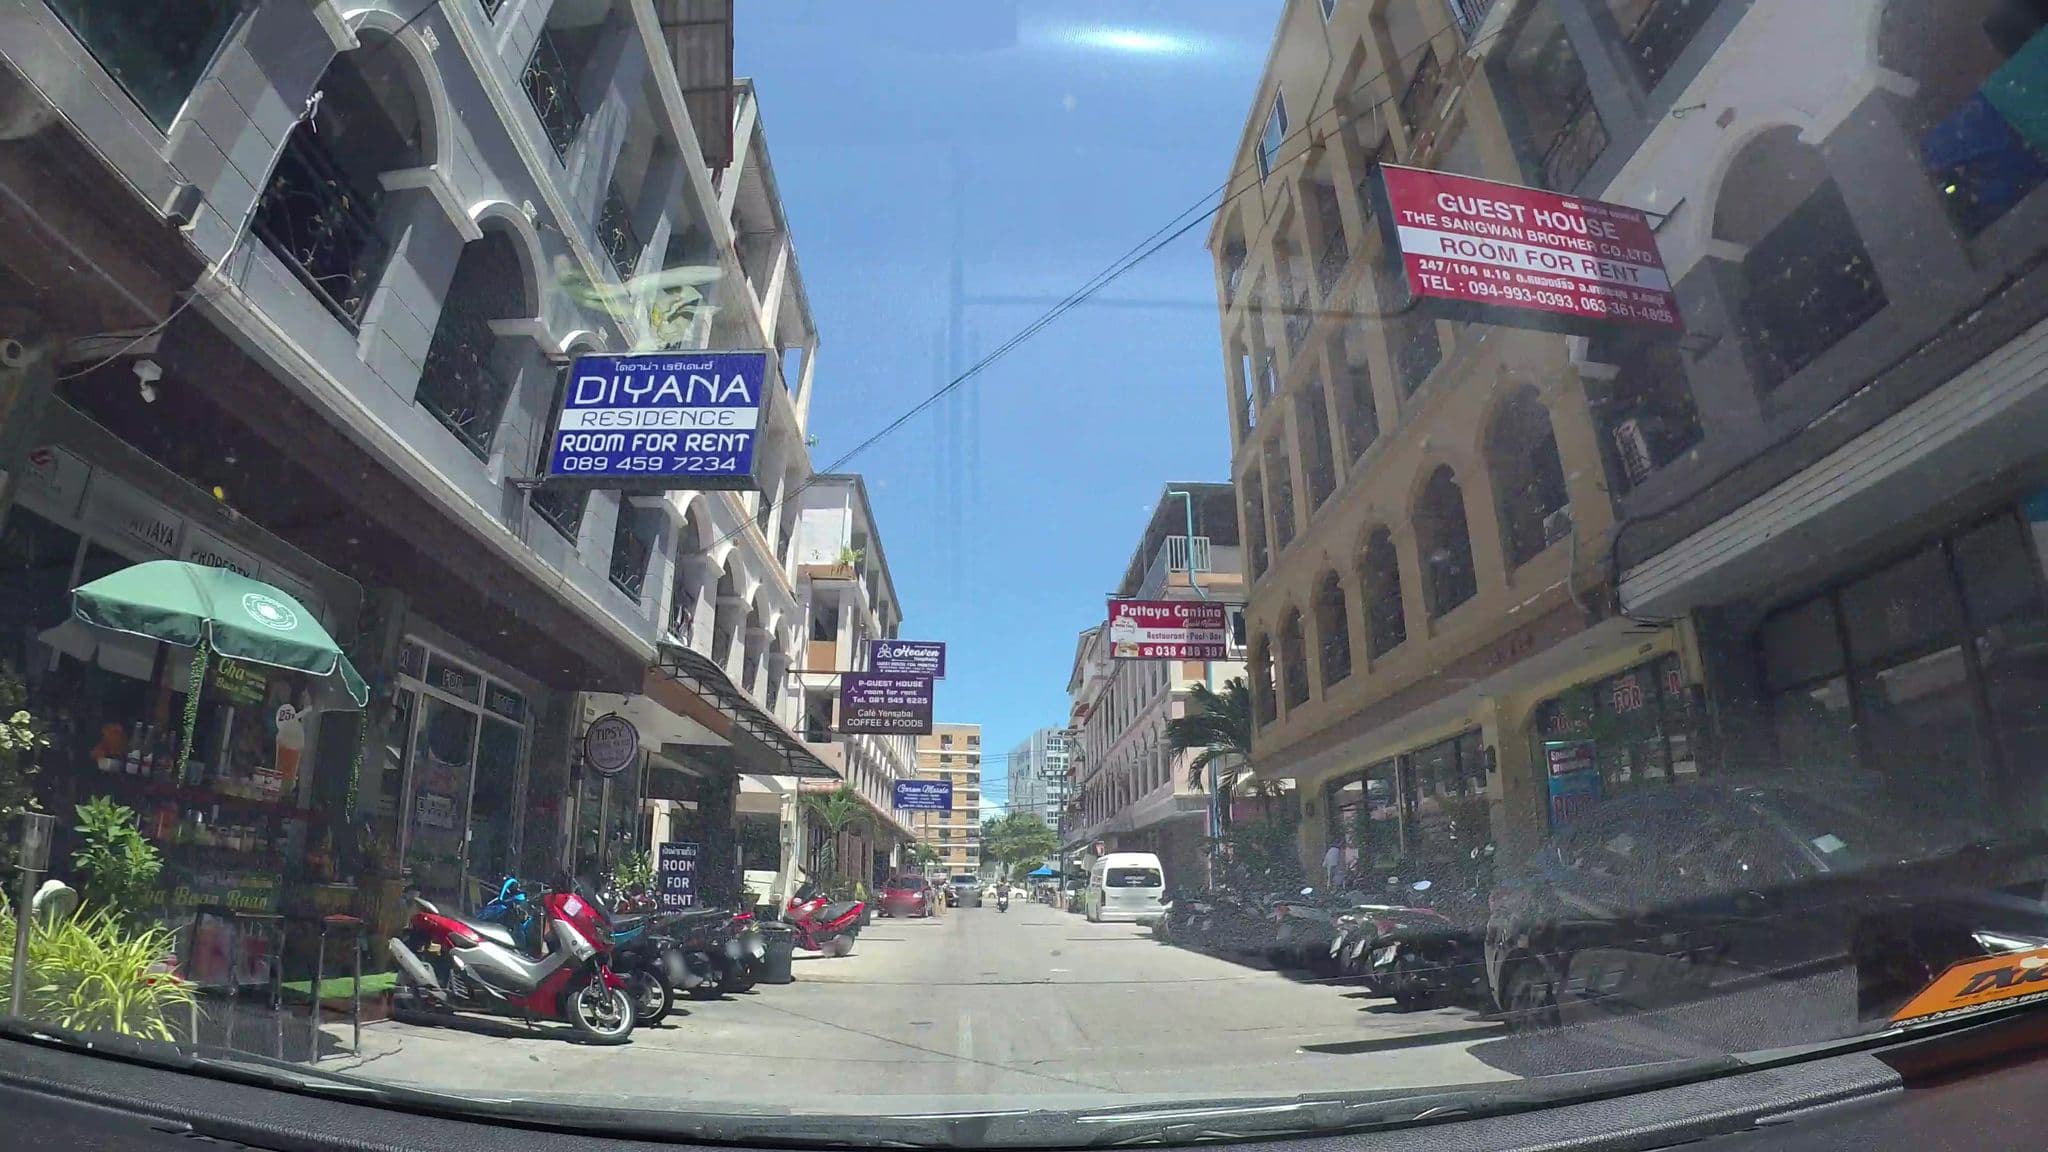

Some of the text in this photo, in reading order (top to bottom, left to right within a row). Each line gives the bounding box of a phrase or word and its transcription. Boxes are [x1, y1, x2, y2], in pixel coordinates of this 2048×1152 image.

[1438, 193, 1525, 223] GUEST
[1533, 208, 1620, 240] HOUSE
[1402, 210, 1438, 226] THE
[1441, 216, 1524, 240] SANGWAN
[1526, 229, 1598, 252] BROTHER
[1440, 237, 1639, 282] ROOM FOR RENT
[1419, 259, 1478, 276] 247/104
[1418, 273, 1455, 291] TEL
[574, 375, 751, 404] DIYANA
[580, 410, 736, 427] RESIDENCE
[560, 434, 750, 452] ROOM FOR RENT
[563, 457, 736, 471] 089 459 7234
[1120, 604, 1221, 619] Pattaya Cantina
[1146, 631, 1185, 640] Restaurant
[893, 645, 940, 657] Heaven
[1155, 646, 1176, 657] 038
[847, 718, 882, 726] COFFEE
[596, 726, 625, 741] TIPSY
[667, 877, 689, 888] FOR
[663, 894, 693, 905] RENT
